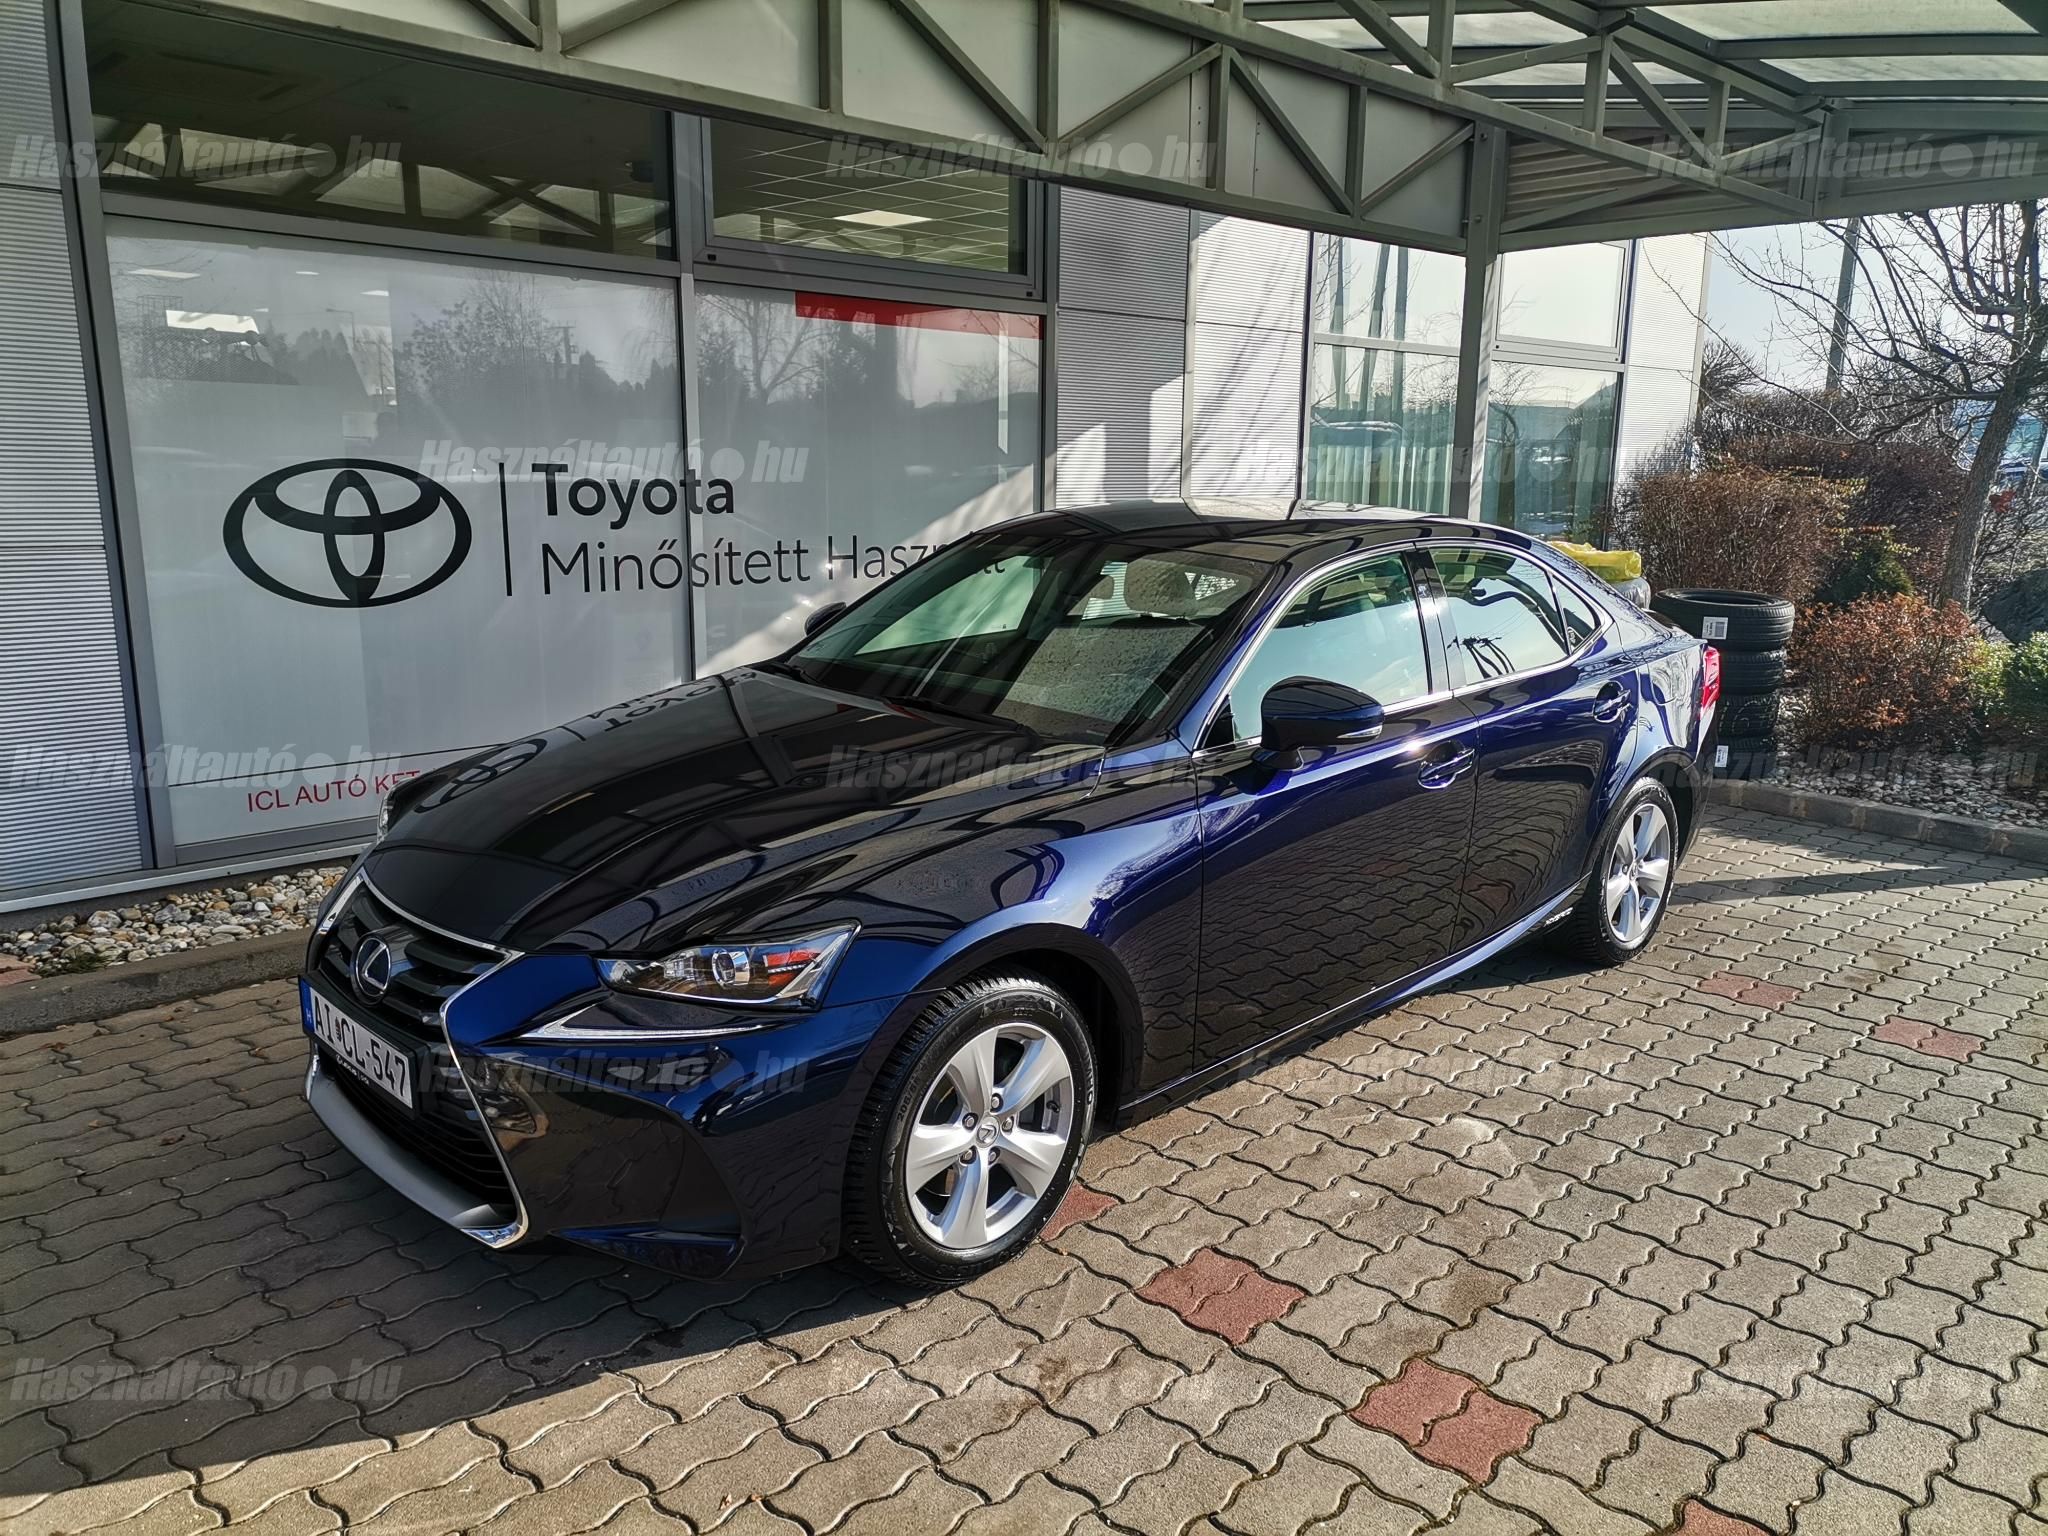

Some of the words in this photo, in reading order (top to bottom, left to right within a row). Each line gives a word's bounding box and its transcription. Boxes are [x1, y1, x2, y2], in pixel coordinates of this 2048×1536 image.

[531, 463, 735, 530] Toyota
[541, 537, 811, 595] Minősített
[247, 788, 290, 813] ICL
[295, 774, 367, 806] AUTÓ
[314, 995, 335, 1045] AI
[341, 1017, 406, 1097] CL-547
